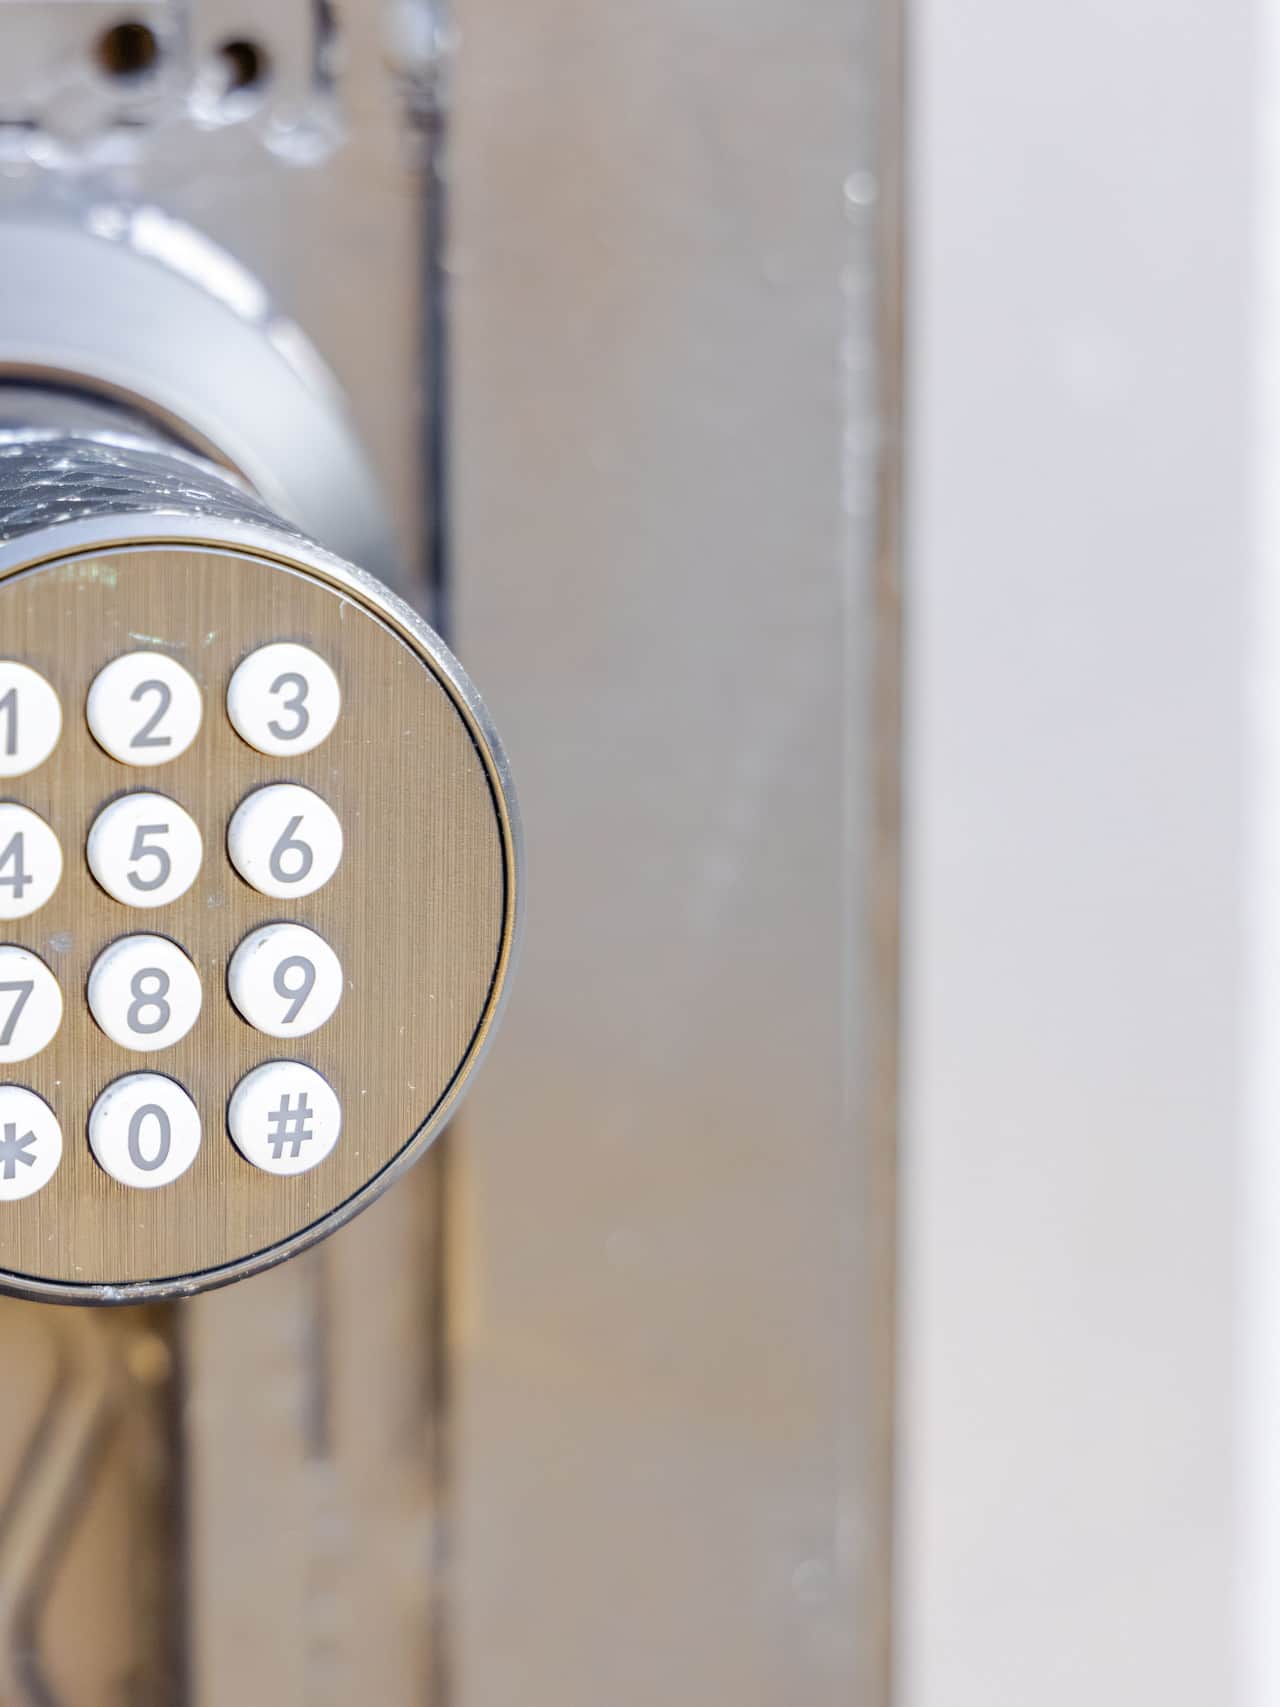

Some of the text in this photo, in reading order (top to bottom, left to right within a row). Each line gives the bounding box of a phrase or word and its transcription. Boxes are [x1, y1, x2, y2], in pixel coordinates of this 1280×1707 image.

[129, 679, 172, 748] 2
[267, 672, 310, 741] 3
[126, 823, 172, 892] 5
[269, 815, 314, 884] 6
[126, 967, 171, 1035] 8
[273, 955, 316, 1025] 9
[127, 1103, 172, 1172] 0
[267, 1092, 314, 1160] #
